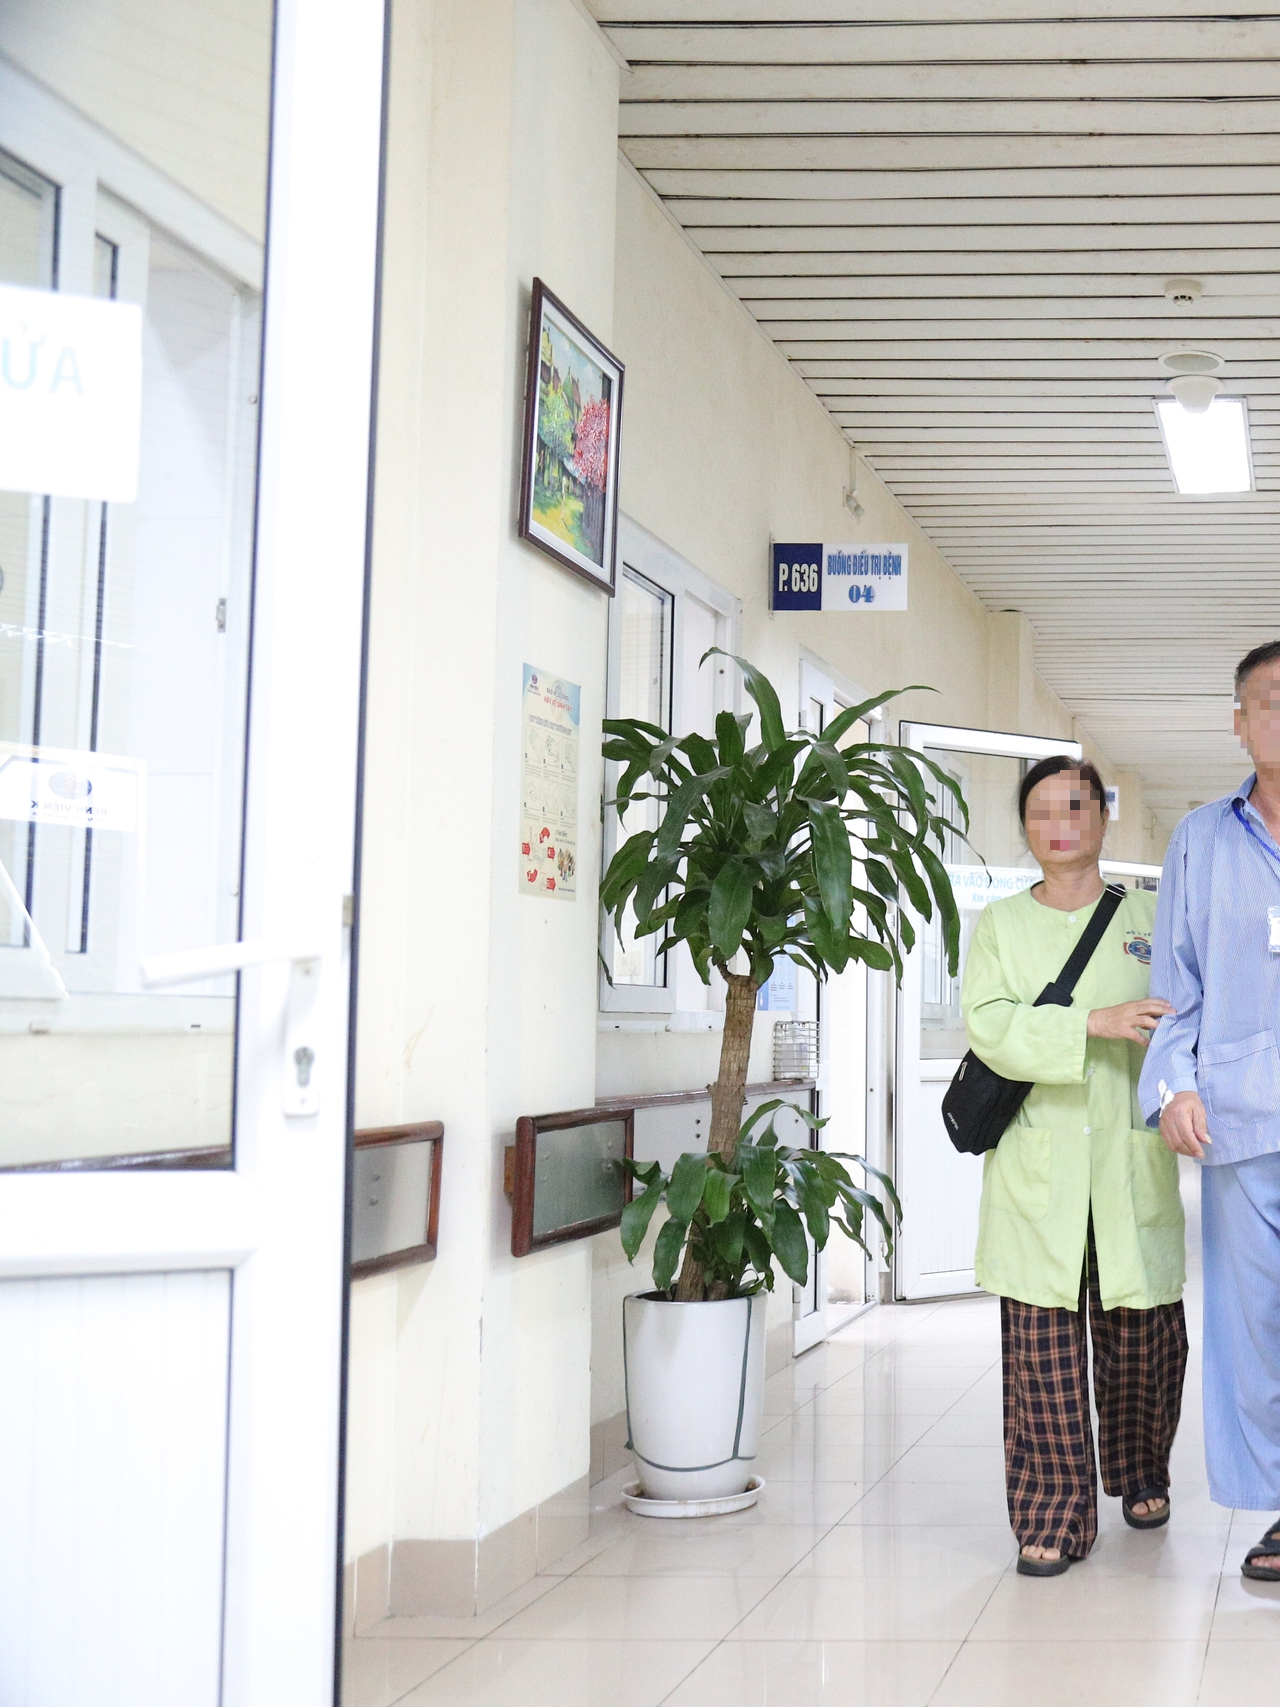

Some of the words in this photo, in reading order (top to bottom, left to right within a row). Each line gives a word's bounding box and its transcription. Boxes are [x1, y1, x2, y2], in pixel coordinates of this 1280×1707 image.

[827, 550, 851, 576] BUỒNG
[852, 550, 869, 576] ĐIỀU
[871, 554, 881, 580] TRỊ
[883, 551, 902, 580] BỆNH
[848, 584, 876, 604] 04
[972, 893, 984, 902] Xin
